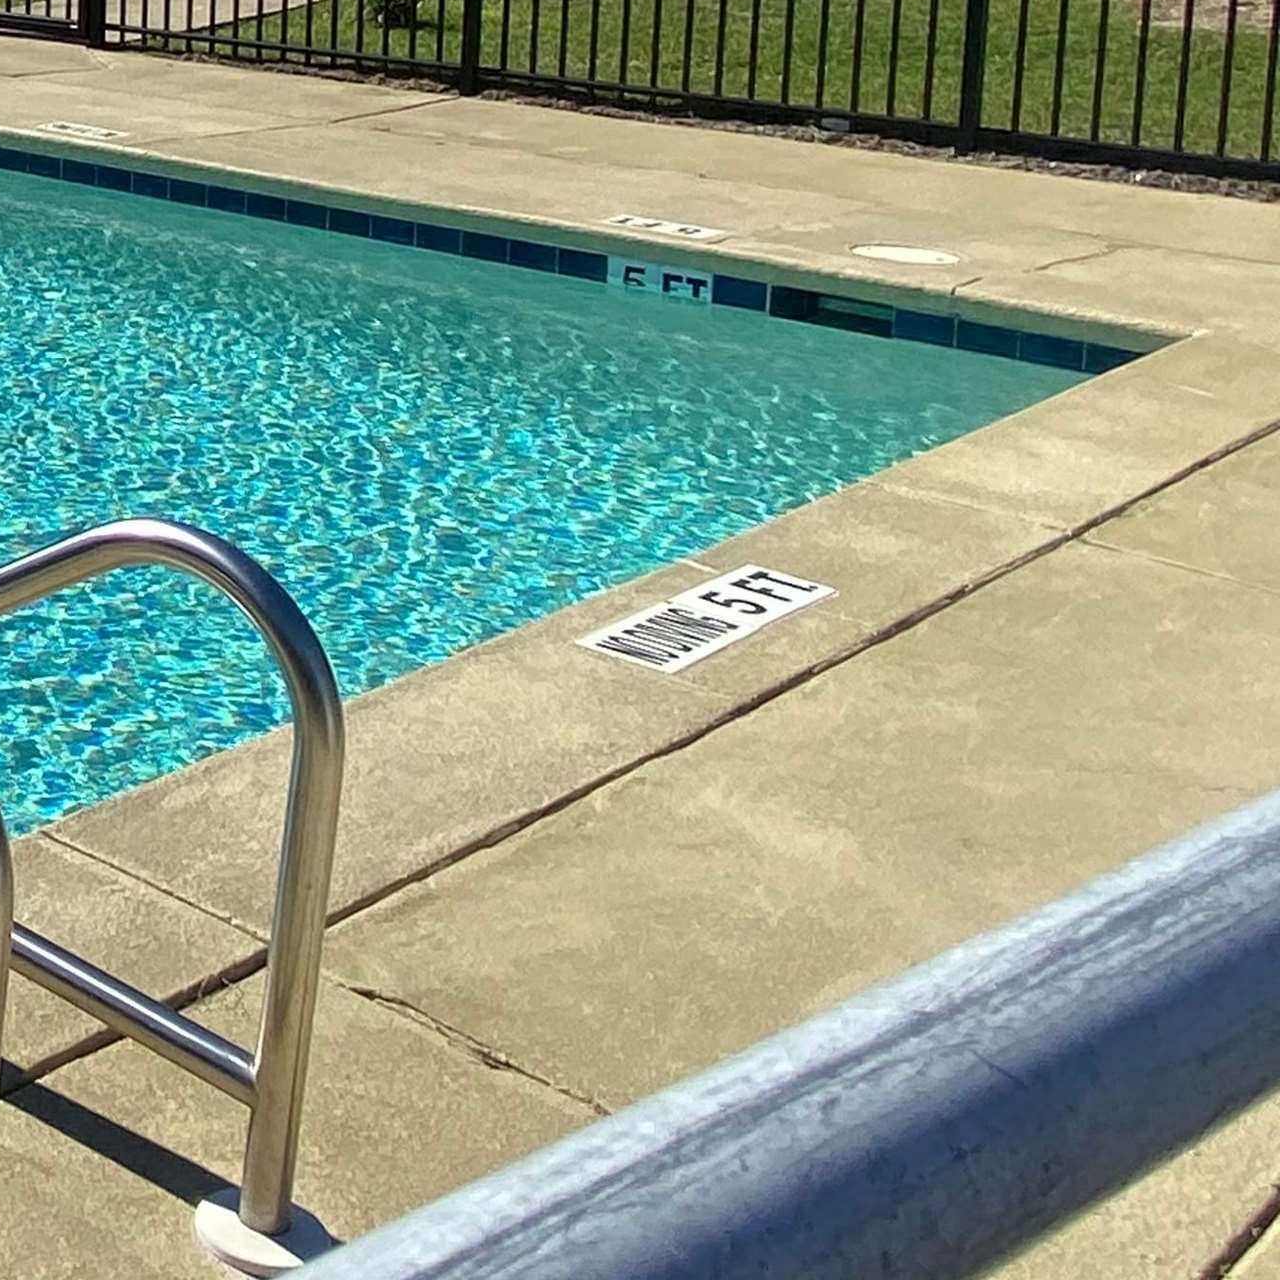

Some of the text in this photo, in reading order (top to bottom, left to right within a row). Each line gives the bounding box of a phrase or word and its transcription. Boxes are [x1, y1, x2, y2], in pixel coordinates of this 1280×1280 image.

[662, 272, 708, 298] FT
[699, 590, 768, 615] 5
[634, 607, 739, 653] DIVING
[596, 635, 679, 666] NO
